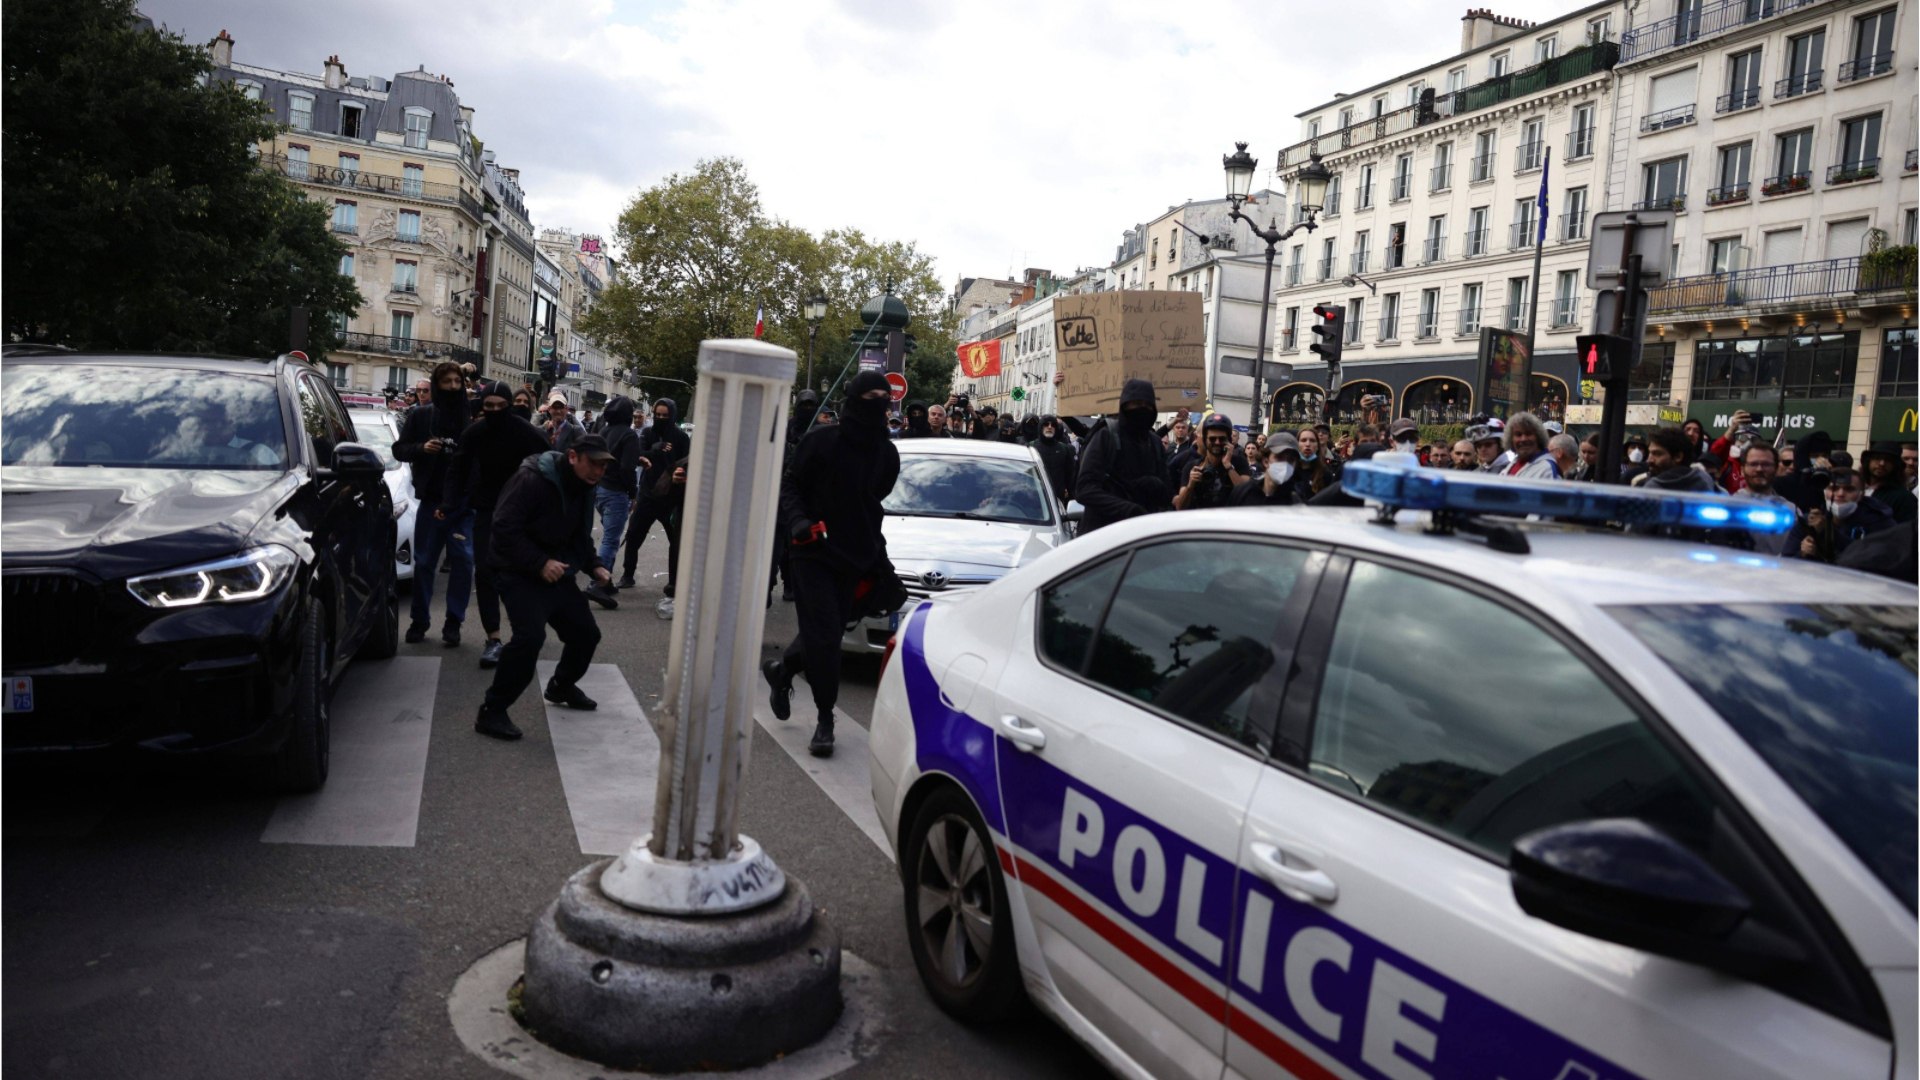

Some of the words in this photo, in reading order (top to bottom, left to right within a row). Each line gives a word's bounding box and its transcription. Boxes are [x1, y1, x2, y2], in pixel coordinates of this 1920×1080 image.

[315, 164, 402, 193] ROYALE
[1061, 322, 1096, 347] Cette
[1713, 413, 1816, 428] Mcnld's
[14, 695, 31, 709] 75
[1058, 785, 1448, 1080] POLICE
